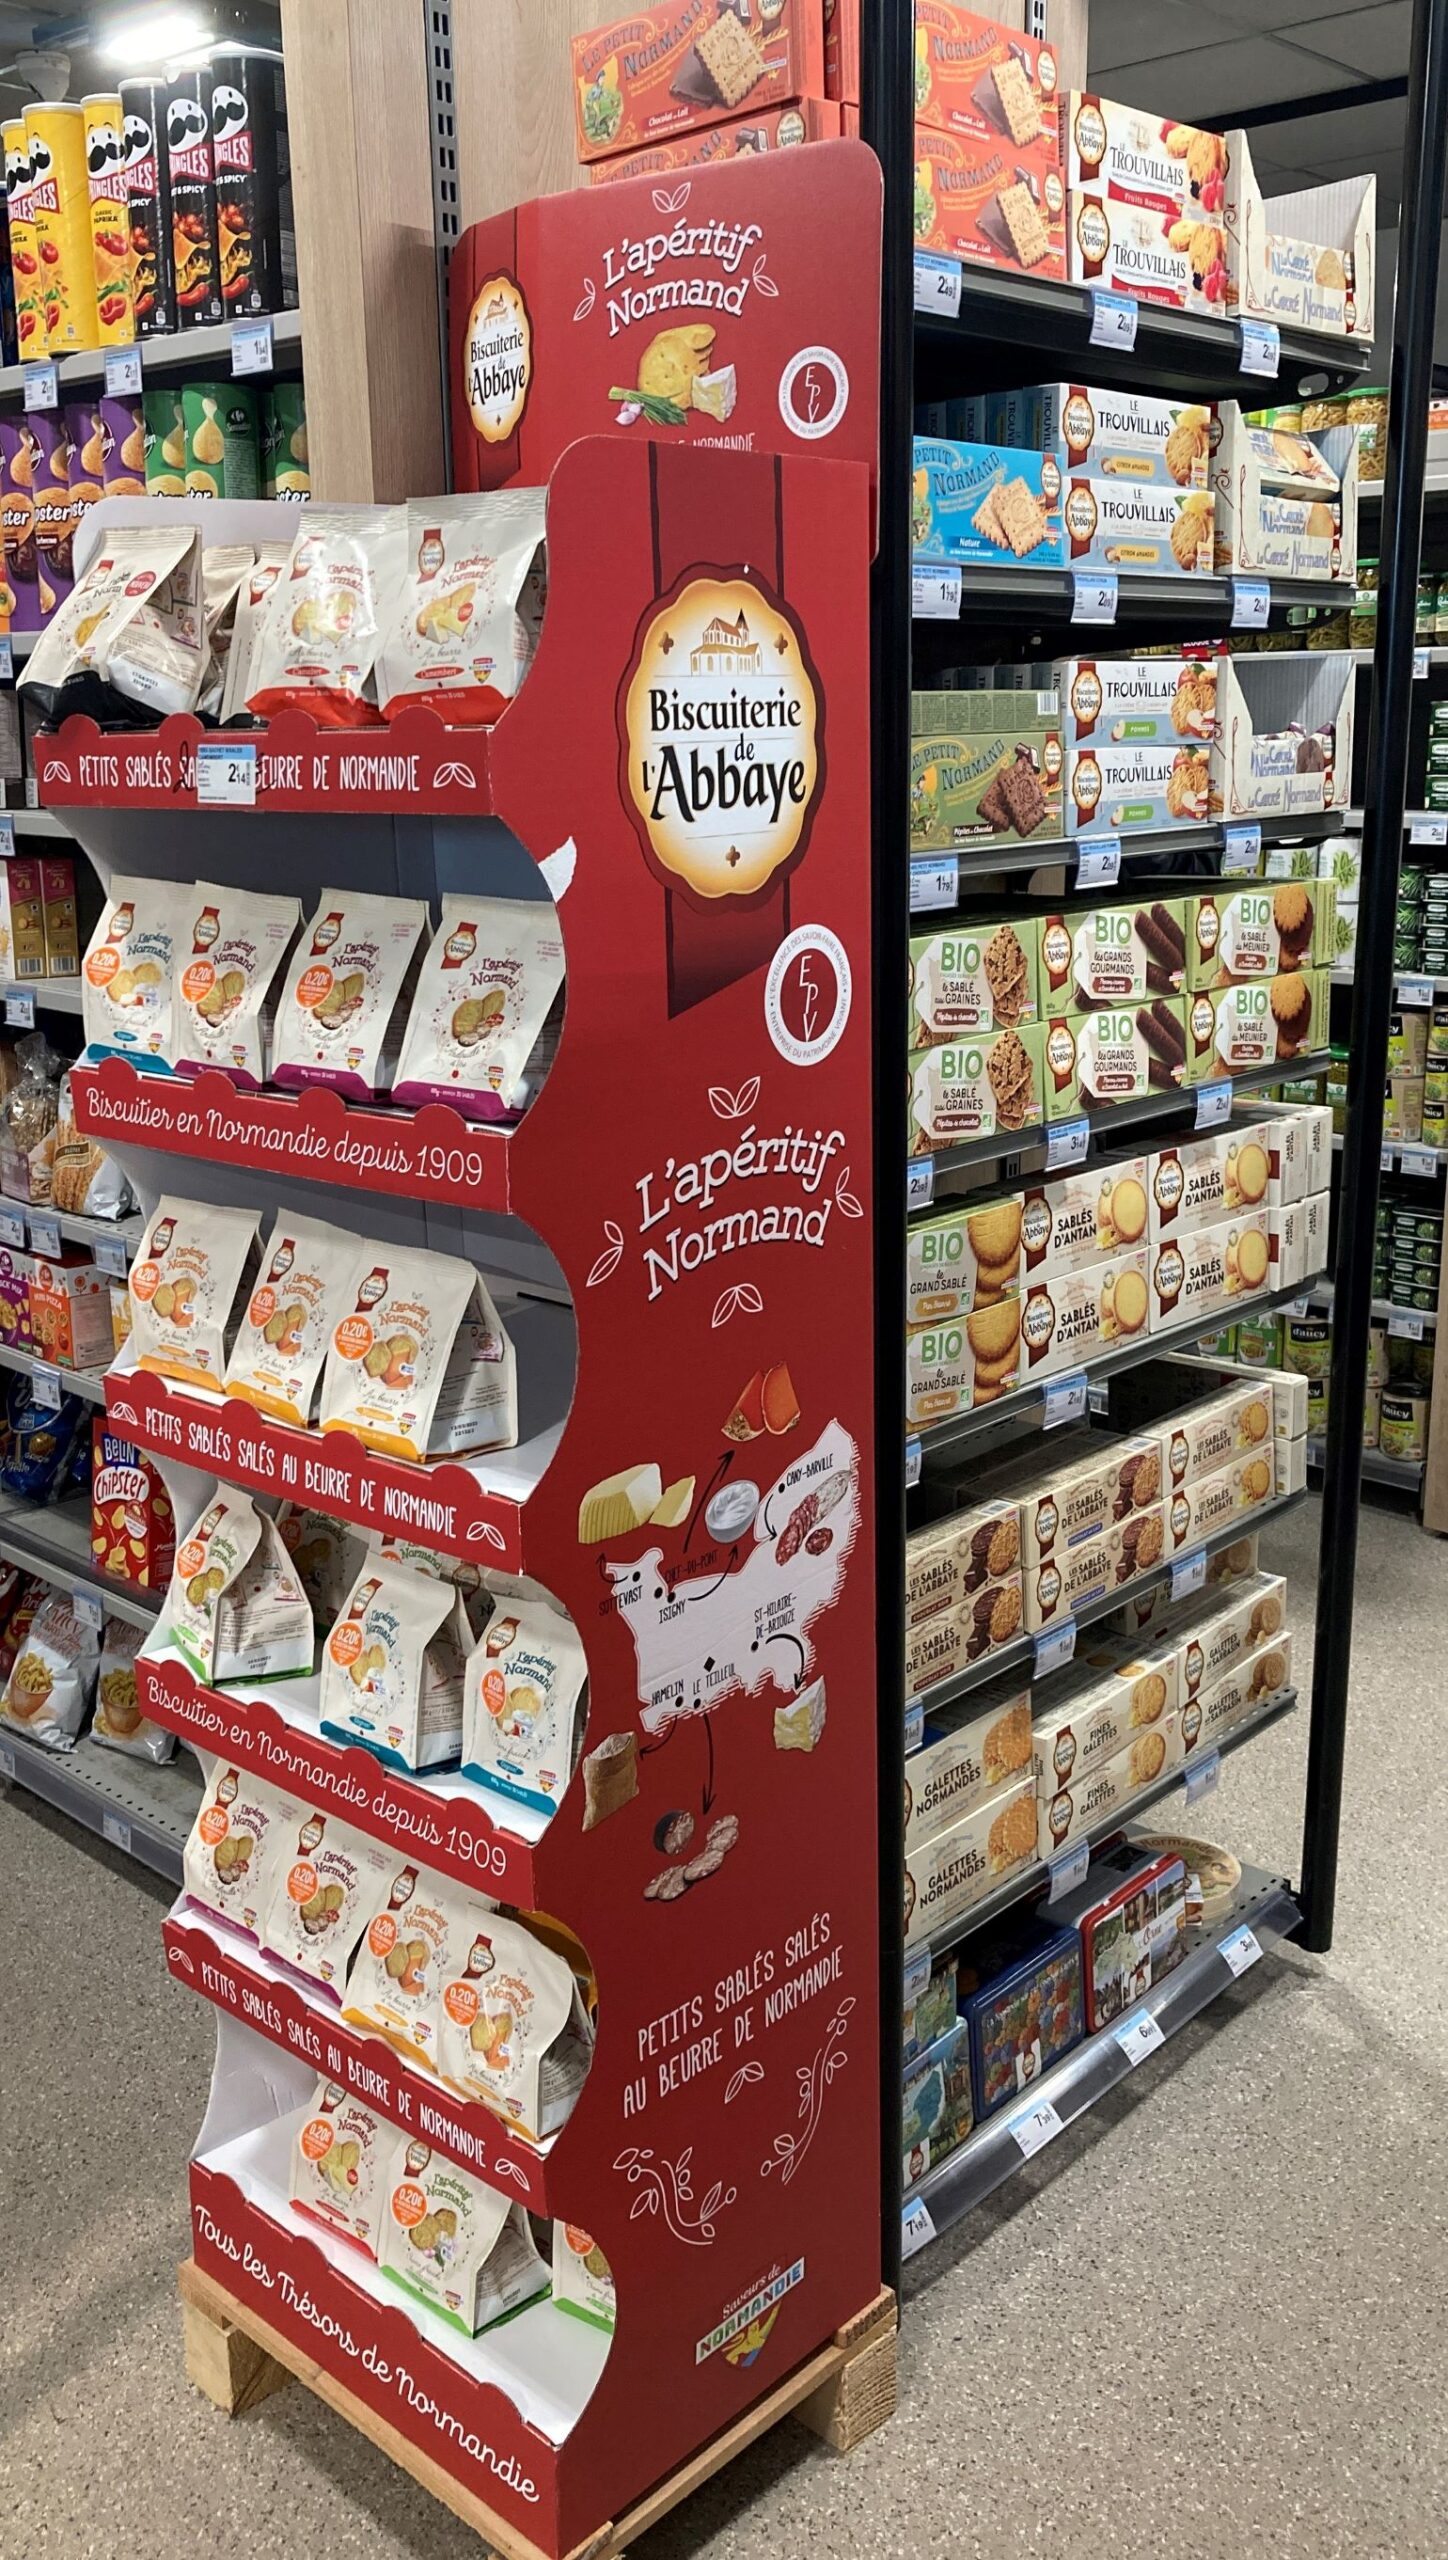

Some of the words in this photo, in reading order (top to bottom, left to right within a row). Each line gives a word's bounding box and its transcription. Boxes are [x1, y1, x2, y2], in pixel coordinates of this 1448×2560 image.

[603, 24, 647, 54] PETIT
[622, 0, 702, 81] NORMAND
[933, 26, 998, 61] NORMAND
[1110, 146, 1184, 187] TROUVILLAIS
[602, 217, 762, 290] L'apéritif
[1113, 243, 1187, 280] TROUVILLAIS
[606, 278, 749, 338] Normand
[470, 328, 525, 363] Biscuiterie
[1098, 411, 1170, 438] TROUVILLAIS
[1101, 500, 1176, 524] TROUVILLAIS
[959, 537, 981, 548] Nature
[1106, 681, 1177, 699] TROUVILLAIS
[649, 687, 802, 732] Biscuiterie
[734, 733, 755, 762] de
[79, 755, 118, 787] PETITS
[125, 750, 172, 788] SABLÉS
[313, 755, 330, 790] DE
[339, 755, 421, 792] NORMANDIE
[941, 738, 1005, 792] NORMAND
[1105, 764, 1173, 785] TROUVILLAIS
[642, 745, 806, 825] l'Abbaye
[1240, 897, 1271, 925] BIO
[1094, 915, 1132, 944] BIO
[940, 942, 981, 973] BIO
[1103, 951, 1132, 963] GRANDS
[1243, 942, 1270, 952] MEUNIER
[1090, 962, 1135, 975] GOURMANDS
[945, 993, 981, 1006] GRAINES
[949, 981, 974, 993] SABLÉ
[1236, 989, 1268, 1015] BIO
[1097, 1015, 1134, 1042] BIO
[1239, 1032, 1268, 1042] MEUNIER
[941, 1049, 983, 1080] BIO
[1093, 1061, 1138, 1073] GOURMANDS
[1106, 1051, 1134, 1061] GRANDS
[945, 1099, 984, 1111] GRAINES
[87, 1087, 174, 1130] Biscuitier
[176, 1112, 202, 1135] en
[206, 1108, 331, 1159] Normandie
[334, 1130, 414, 1176] depuis
[415, 1145, 483, 1185] 1909
[635, 1124, 846, 1232] L'apéritif
[1189, 1171, 1221, 1191] SABLÉS
[1185, 1185, 1224, 1208] D'ANTAN
[1058, 1208, 1093, 1232] SABLÉS
[642, 1199, 832, 1301] Normand
[921, 1231, 963, 1264] BIO
[1054, 1222, 1097, 1249] D'ANTAN
[1185, 1272, 1225, 1294] D'ANTAN
[1189, 1258, 1222, 1280] SABLÉS
[910, 1279, 940, 1295] GRAND
[1061, 1302, 1096, 1327] SABLÉS
[1057, 1316, 1100, 1344] D'ANTAN
[921, 1331, 962, 1363] BIO
[910, 1378, 940, 1395] GRAND
[145, 1405, 182, 1445] PETITS
[188, 1421, 231, 1463] SABLÉS
[238, 1434, 275, 1477] SALÉS
[282, 1452, 298, 1486] AU
[305, 1459, 352, 1503] BEURRE
[360, 1478, 376, 1513] DE
[384, 1486, 457, 1539] NORMANDIE
[920, 1558, 953, 1582] SABLÉS
[1079, 1552, 1106, 1573] SABLÉS
[922, 1627, 955, 1653] SABLÉS
[1209, 1631, 1238, 1659] GALETTES
[1207, 1687, 1239, 1715] GALETTES
[1083, 1725, 1118, 1757] GALETTES
[1089, 1719, 1111, 1739] FINES
[147, 1675, 229, 1738] Biscuitier
[230, 1723, 254, 1749] en
[257, 1730, 370, 1809] Normandie
[372, 1789, 443, 1845] depuis
[444, 1826, 507, 1877] 1909
[924, 1758, 973, 1798] GALETTES
[1087, 1779, 1109, 1800] FINES
[916, 1766, 981, 1817] NORMANDES
[1080, 1783, 1116, 1816] GALETTES
[919, 1857, 986, 1909] NORMANDES
[928, 1849, 978, 1890] GALETTES
[638, 1994, 704, 2062] PETITS
[715, 1950, 775, 2013] SABLÉS
[785, 1912, 831, 1967] SALÉS
[623, 2084, 647, 2119] AU
[659, 2028, 723, 2098] BEURRE
[734, 2006, 755, 2048] DE
[765, 1944, 844, 2028] NORMANDIE
[201, 1962, 237, 2004] PETITS
[241, 1988, 283, 2034] SABLÉS
[287, 2014, 321, 2060] SALÉS
[327, 2043, 342, 2074] AU
[348, 2052, 391, 2107] BEURRE
[398, 2088, 413, 2122] DE
[419, 2099, 487, 2169] NORMANDIE
[722, 2274, 766, 2319] Saveurs
[767, 2263, 782, 2278] de
[699, 2261, 803, 2359] NORMANDIE
[195, 2205, 243, 2260] Tous
[242, 2241, 275, 2290] les
[276, 2271, 362, 2356] Trésors
[362, 2348, 394, 2383] de
[395, 2367, 541, 2503] Normandie
